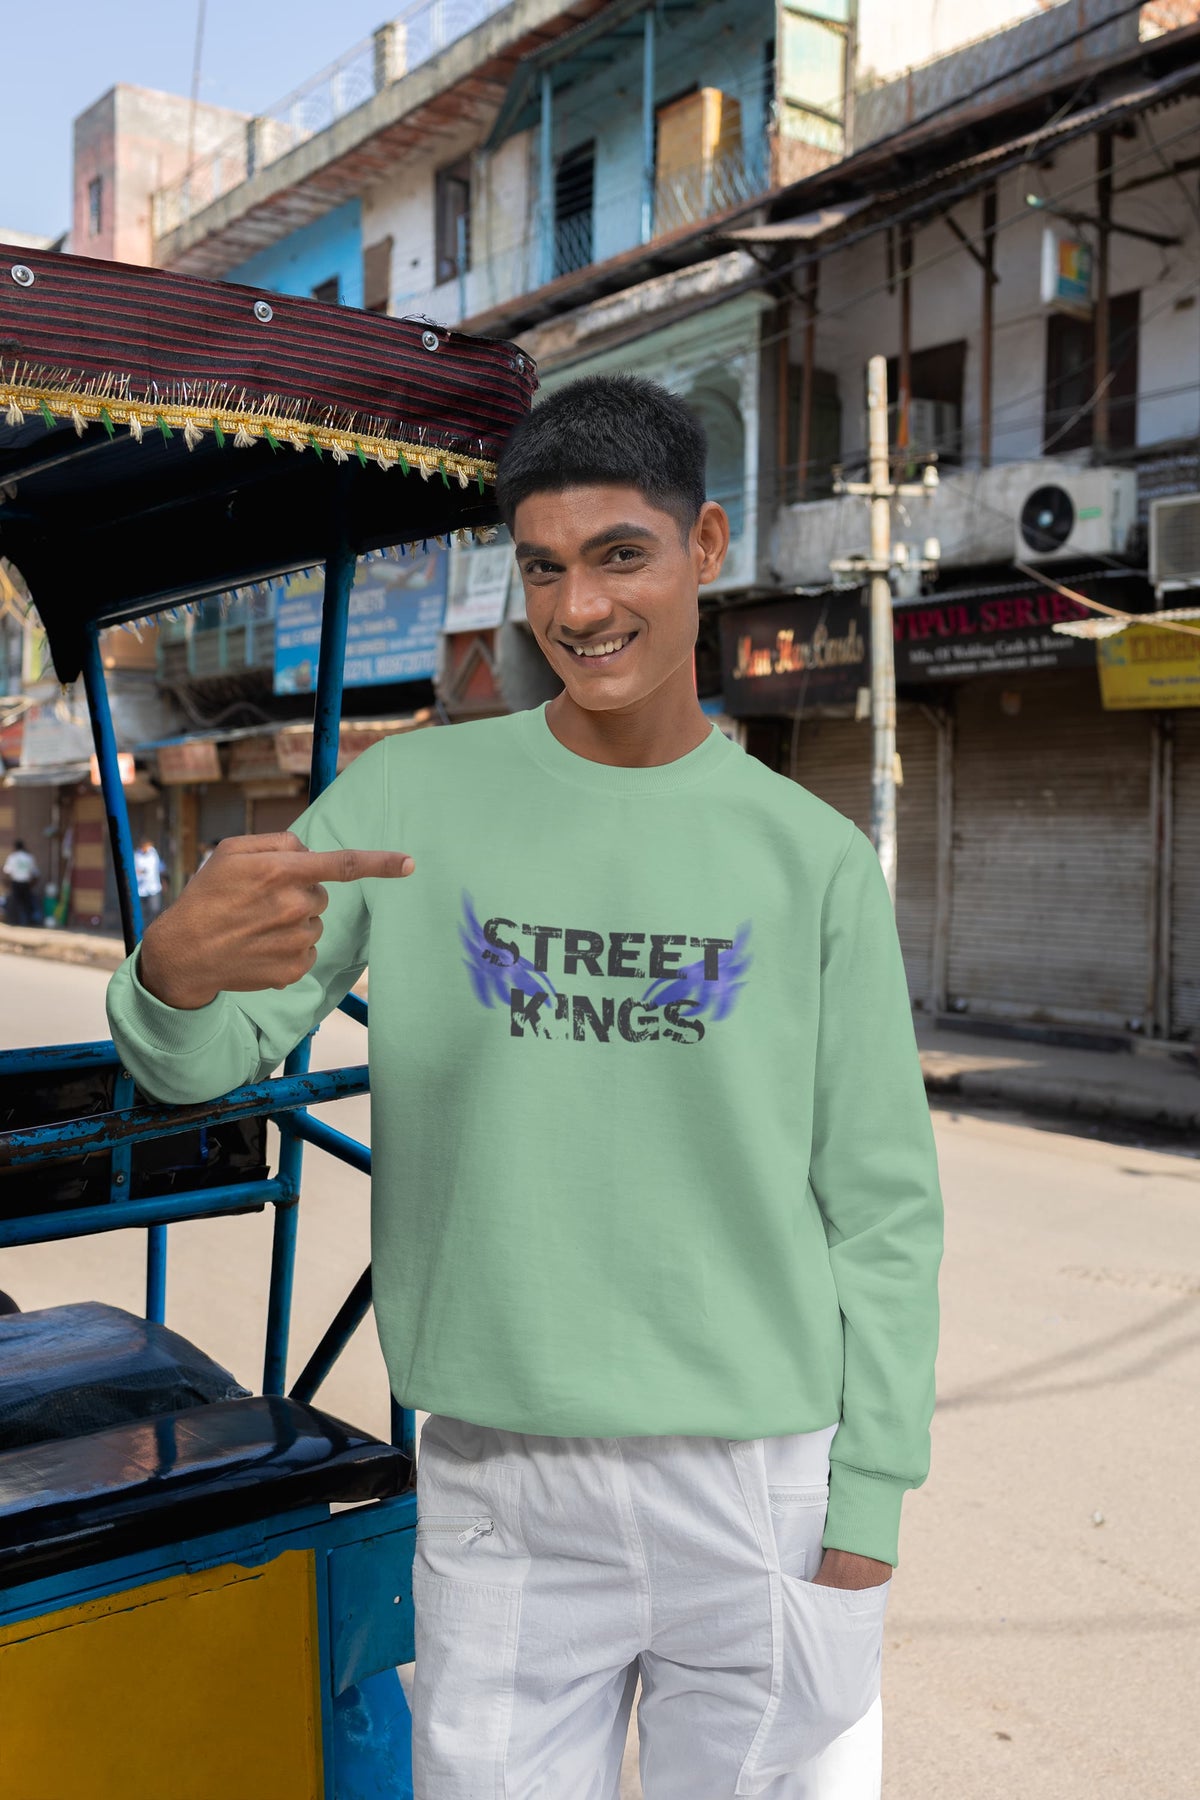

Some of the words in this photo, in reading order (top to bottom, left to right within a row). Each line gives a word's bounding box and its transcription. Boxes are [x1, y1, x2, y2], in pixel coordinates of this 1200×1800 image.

[893, 605, 977, 641] VIPUL
[980, 589, 1089, 632] SERIES
[481, 917, 734, 982] STREET
[510, 988, 706, 1045] KINGS
